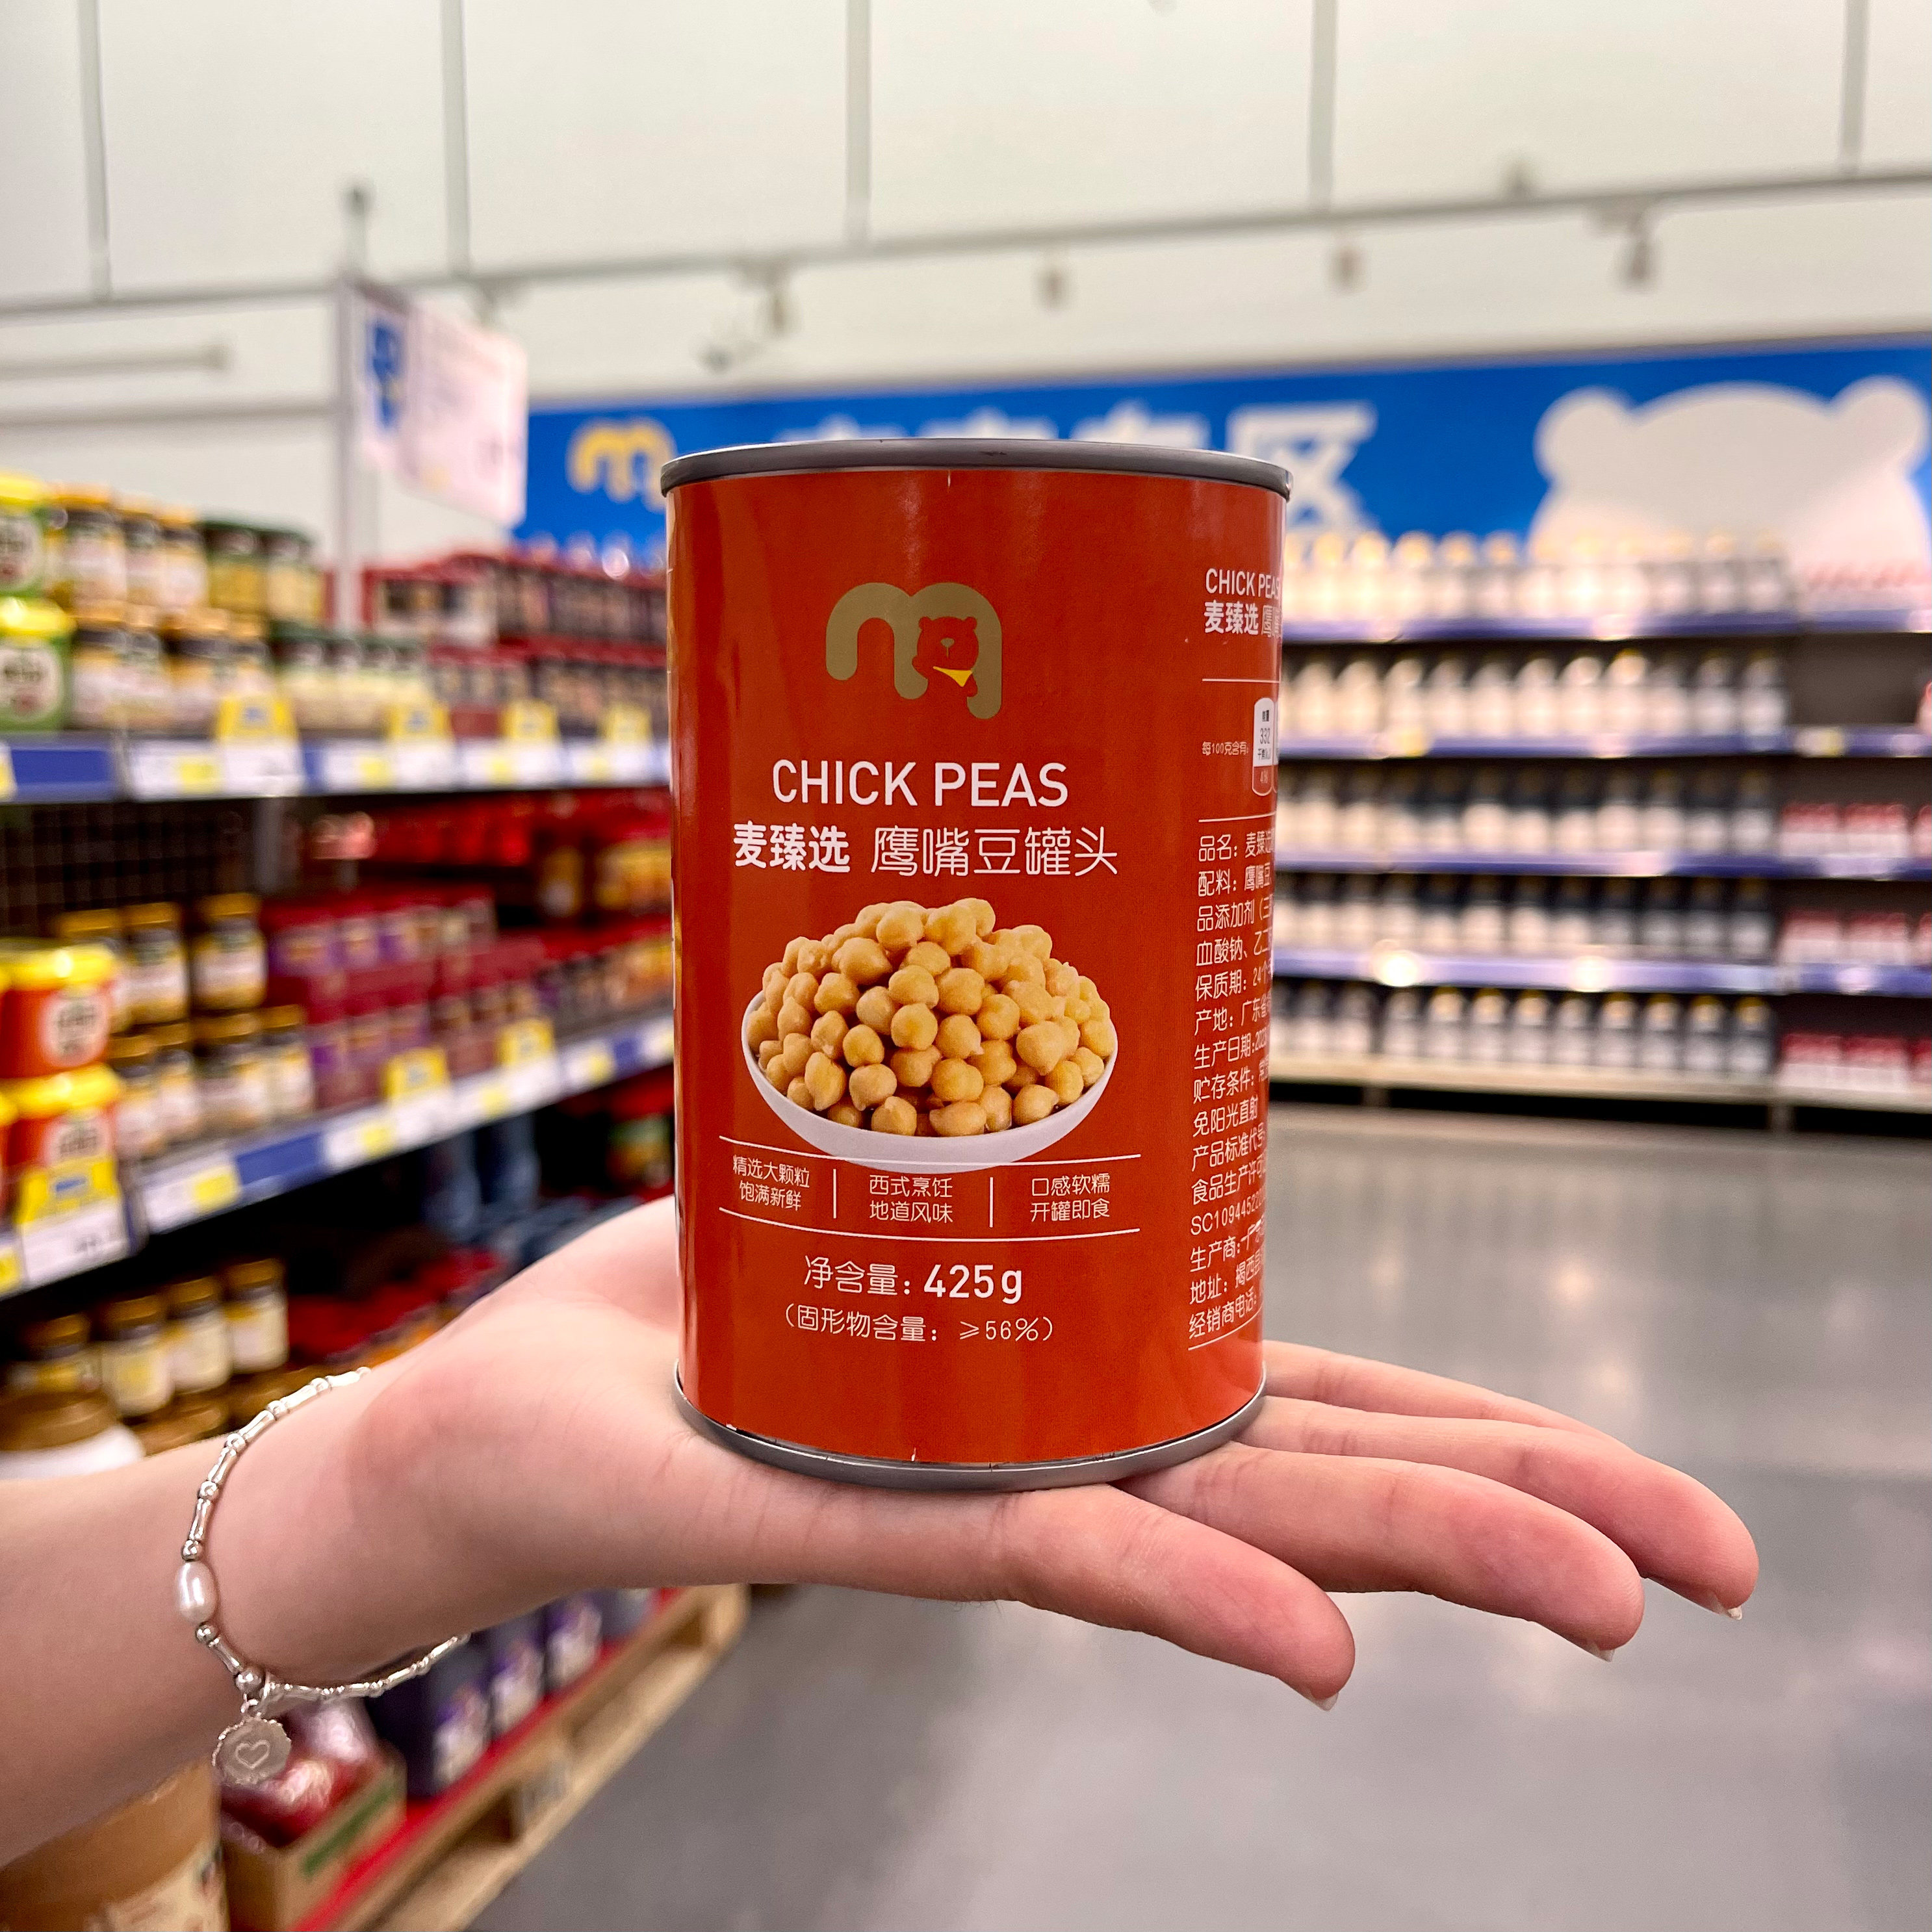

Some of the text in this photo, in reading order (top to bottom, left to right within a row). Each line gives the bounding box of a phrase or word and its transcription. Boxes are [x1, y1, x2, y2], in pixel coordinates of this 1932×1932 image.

[1205, 567, 1256, 597] CHICK
[1204, 599, 1259, 636] 麦臻选
[772, 759, 1069, 807] CHICK PEAS
[733, 819, 1118, 877] 麦臻选 鹰嘴豆罐头
[1192, 1094, 1259, 1137] 免阳光直射
[732, 1153, 810, 1189] 精选大颗粒
[869, 1174, 953, 1198] 西式烹饪
[1031, 1172, 1111, 1197] 口感软糯
[738, 1181, 803, 1212] 饱满新鲜
[869, 1199, 953, 1223] 地道风味
[1029, 1198, 1111, 1222] 开罐即食
